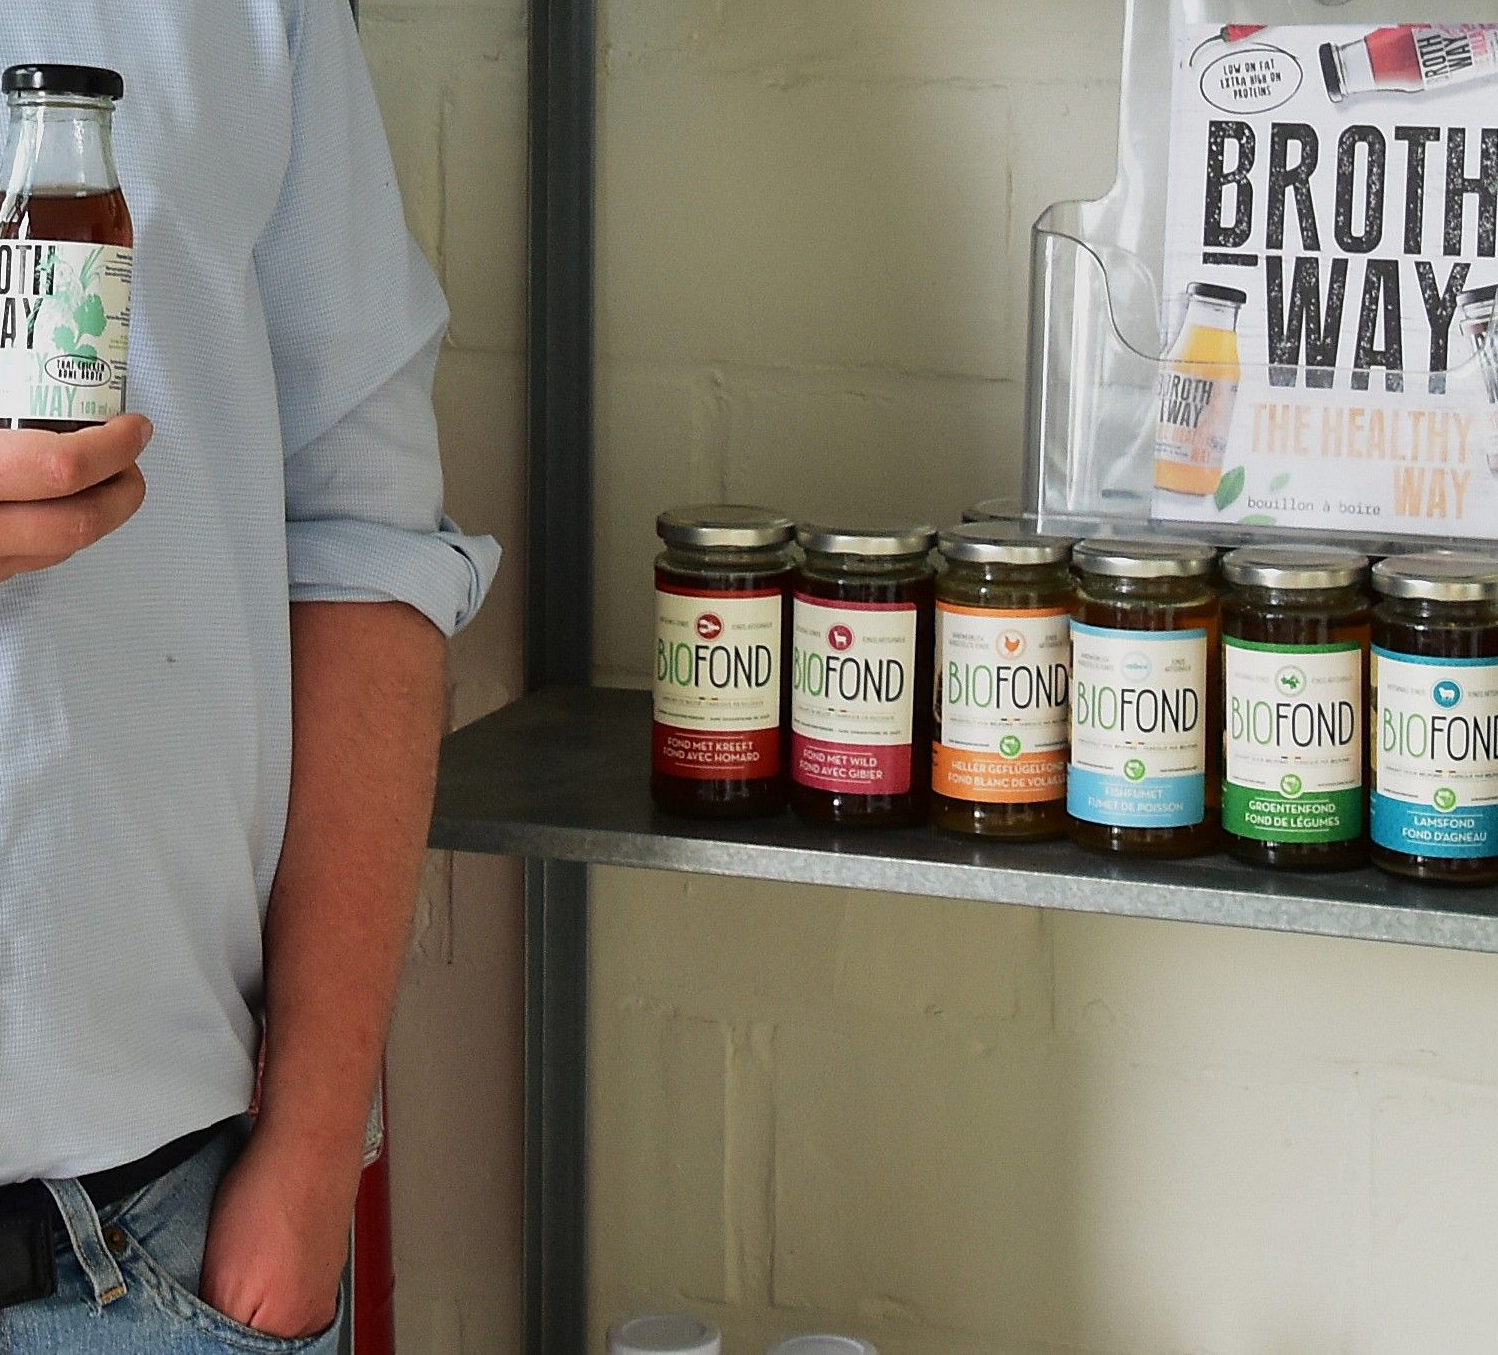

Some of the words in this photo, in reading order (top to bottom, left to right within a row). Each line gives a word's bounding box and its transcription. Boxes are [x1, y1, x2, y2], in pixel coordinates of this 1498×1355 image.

[1223, 63, 1241, 76] LOW
[1244, 62, 1257, 73] ON
[1259, 58, 1275, 72] FAT
[1220, 76, 1247, 89] EXTRA
[1250, 74, 1268, 85] HIGH
[1270, 71, 1281, 82] ON
[1233, 85, 1271, 100] PROTEINS
[1264, 253, 1472, 395] WAY
[29, 385, 77, 417] WAY
[1249, 402, 1309, 458] THE
[1319, 405, 1473, 464] HEALTHY
[1391, 466, 1473, 520] WAY
[1247, 496, 1315, 513] bouillon
[1322, 500, 1331, 513] à
[1338, 502, 1382, 515] boire
[657, 638, 772, 689] BIOFOND
[794, 646, 905, 703] BIOFOND
[948, 661, 1069, 709] BIOFOND
[1077, 681, 1199, 733] BIOFOND
[1231, 696, 1356, 747] BIOFOND
[667, 737, 691, 750] FOND
[692, 741, 713, 751] MET
[715, 741, 754, 752] KREEFT
[663, 746, 686, 759] FOND
[686, 751, 713, 762] AVEC
[714, 751, 760, 763] HOMARD
[803, 749, 826, 763] FOND
[827, 755, 848, 766] MET
[849, 756, 877, 767] WILD
[821, 767, 847, 778] AVEC
[848, 769, 883, 780] GIBIER
[947, 772, 973, 785] FOND
[973, 777, 1010, 788] BLANC
[1011, 778, 1025, 788] DE
[1248, 800, 1336, 814] GROENTENFOND
[1244, 812, 1272, 826] FOND
[1273, 817, 1288, 827] DE
[1290, 815, 1340, 827] LÉGUMES
[1413, 815, 1476, 828] LAMSFOND
[1402, 827, 1432, 840] FOND
[1433, 830, 1488, 842] D'AGNEAU
